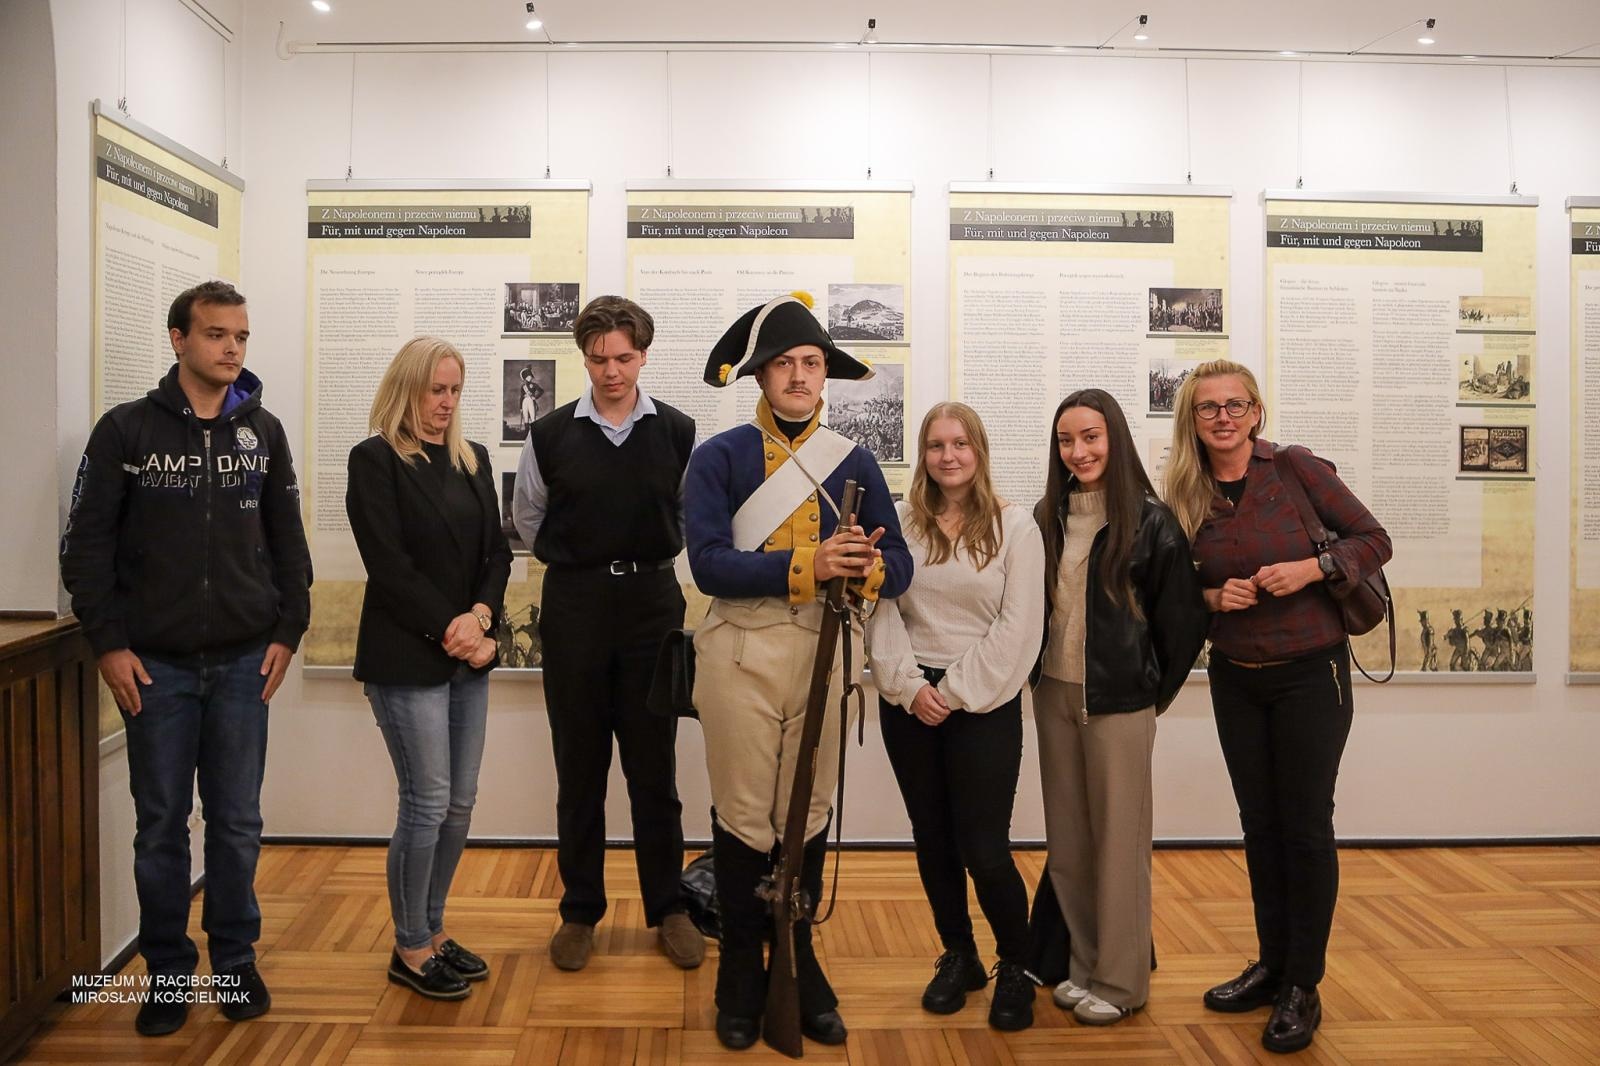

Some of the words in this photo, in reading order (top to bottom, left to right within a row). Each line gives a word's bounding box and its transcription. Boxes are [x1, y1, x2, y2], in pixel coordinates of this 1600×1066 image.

[106, 143, 113, 156] Z
[114, 146, 152, 175] Napoleonem
[157, 169, 178, 185] przeciw
[178, 180, 194, 195] niemu
[122, 174, 132, 187] mit
[134, 181, 145, 193] und
[147, 187, 162, 201] gegen
[164, 191, 189, 212] Napoleon
[322, 209, 330, 219] Z
[333, 209, 394, 221] Napoleonem
[398, 209, 401, 218] i
[405, 209, 443, 221] przeciw
[446, 209, 476, 219] niemu
[641, 209, 649, 219] Z
[653, 209, 716, 221] Napoleonem
[720, 209, 723, 219] i
[726, 209, 764, 221] przeciw
[767, 210, 799, 219] niemu
[964, 211, 972, 221] Z
[975, 212, 1037, 224] Napoleonem
[1041, 212, 1044, 222] i
[1048, 213, 1086, 225] przeciw
[1089, 213, 1120, 223] niemu
[322, 226, 341, 237] Für,
[344, 226, 361, 235] mit
[364, 226, 384, 235] und
[386, 228, 415, 238] gegen
[418, 226, 465, 238] Napoleon
[641, 225, 661, 237] Für,
[664, 226, 681, 235] mit
[684, 226, 704, 235] und
[707, 228, 736, 238] gegen
[740, 226, 788, 238] Napoleon
[1280, 219, 1288, 228] Z
[1292, 219, 1352, 231] Napoleonem
[1355, 220, 1358, 230] i
[1361, 221, 1399, 233] przeciw
[1401, 222, 1431, 232] niemu
[1585, 225, 1593, 236] Z
[964, 228, 984, 240] Für,
[987, 228, 1004, 238] mit
[1007, 228, 1027, 239] und
[1030, 231, 1058, 241] gegen
[1062, 229, 1109, 241] Napoleon
[1280, 235, 1300, 246] Für,
[1303, 236, 1320, 246] mit
[1322, 236, 1341, 246] und
[1344, 239, 1372, 249] gegen
[1374, 237, 1421, 248] Napoleon
[1585, 240, 1600, 252] Fü
